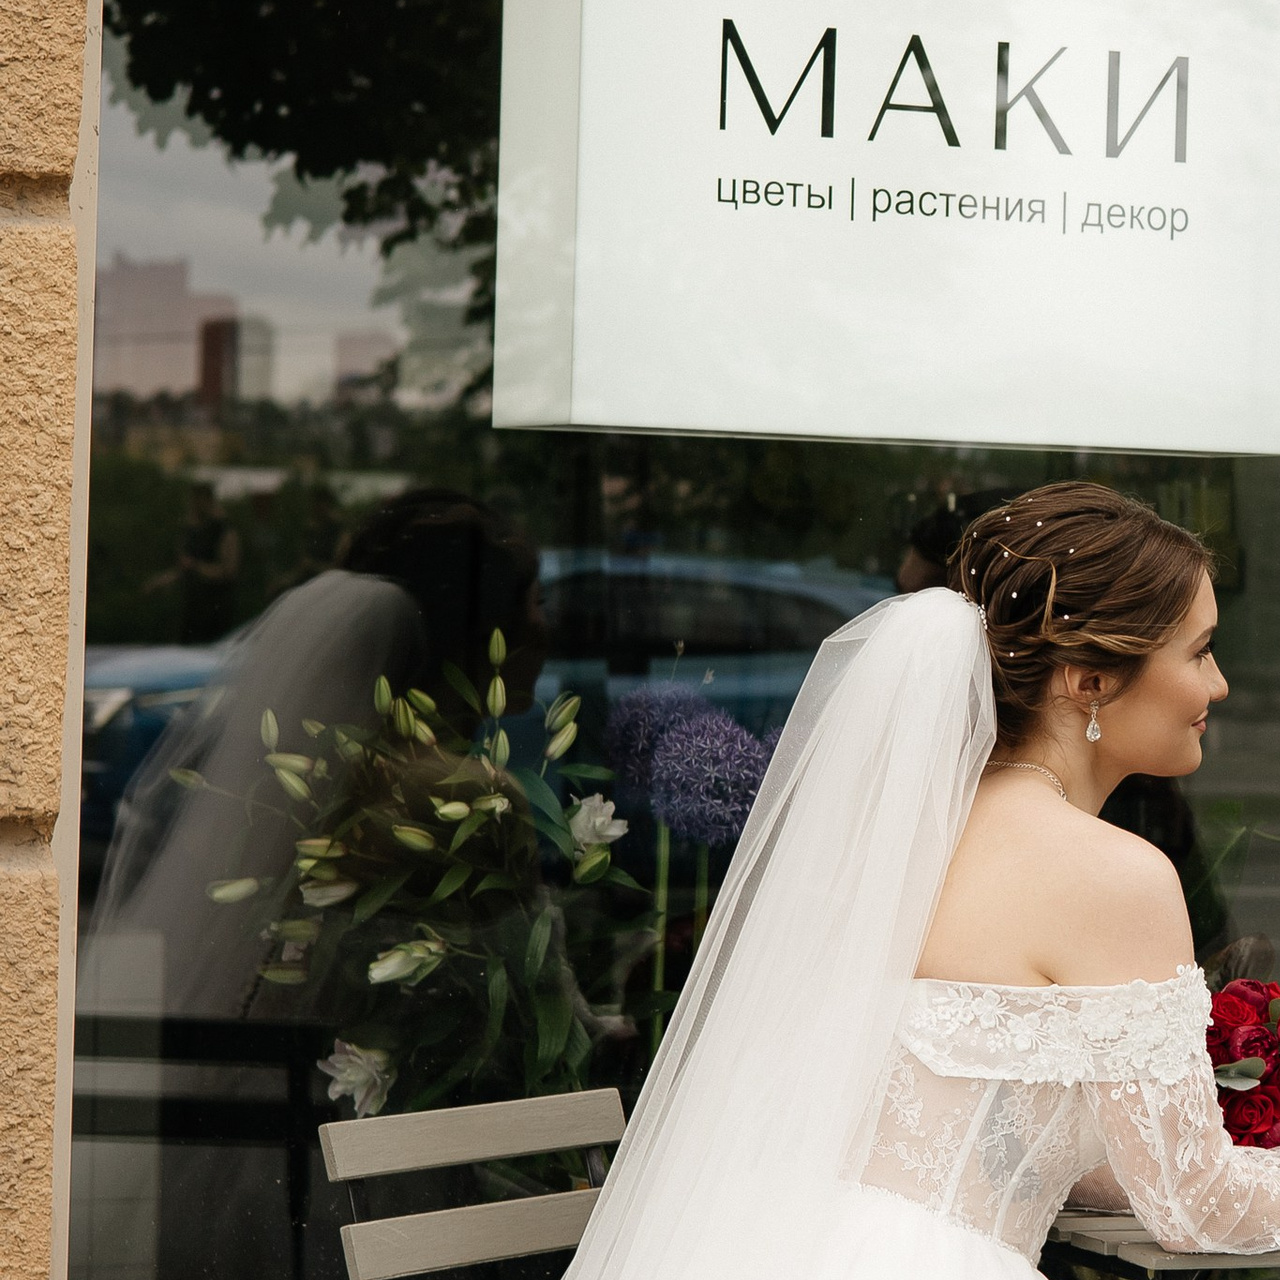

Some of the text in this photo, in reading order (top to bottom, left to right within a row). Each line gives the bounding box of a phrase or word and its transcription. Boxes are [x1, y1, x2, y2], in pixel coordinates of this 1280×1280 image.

[719, 18, 1190, 163] МАКИ
[716, 177, 1190, 241] цветы растения декор
